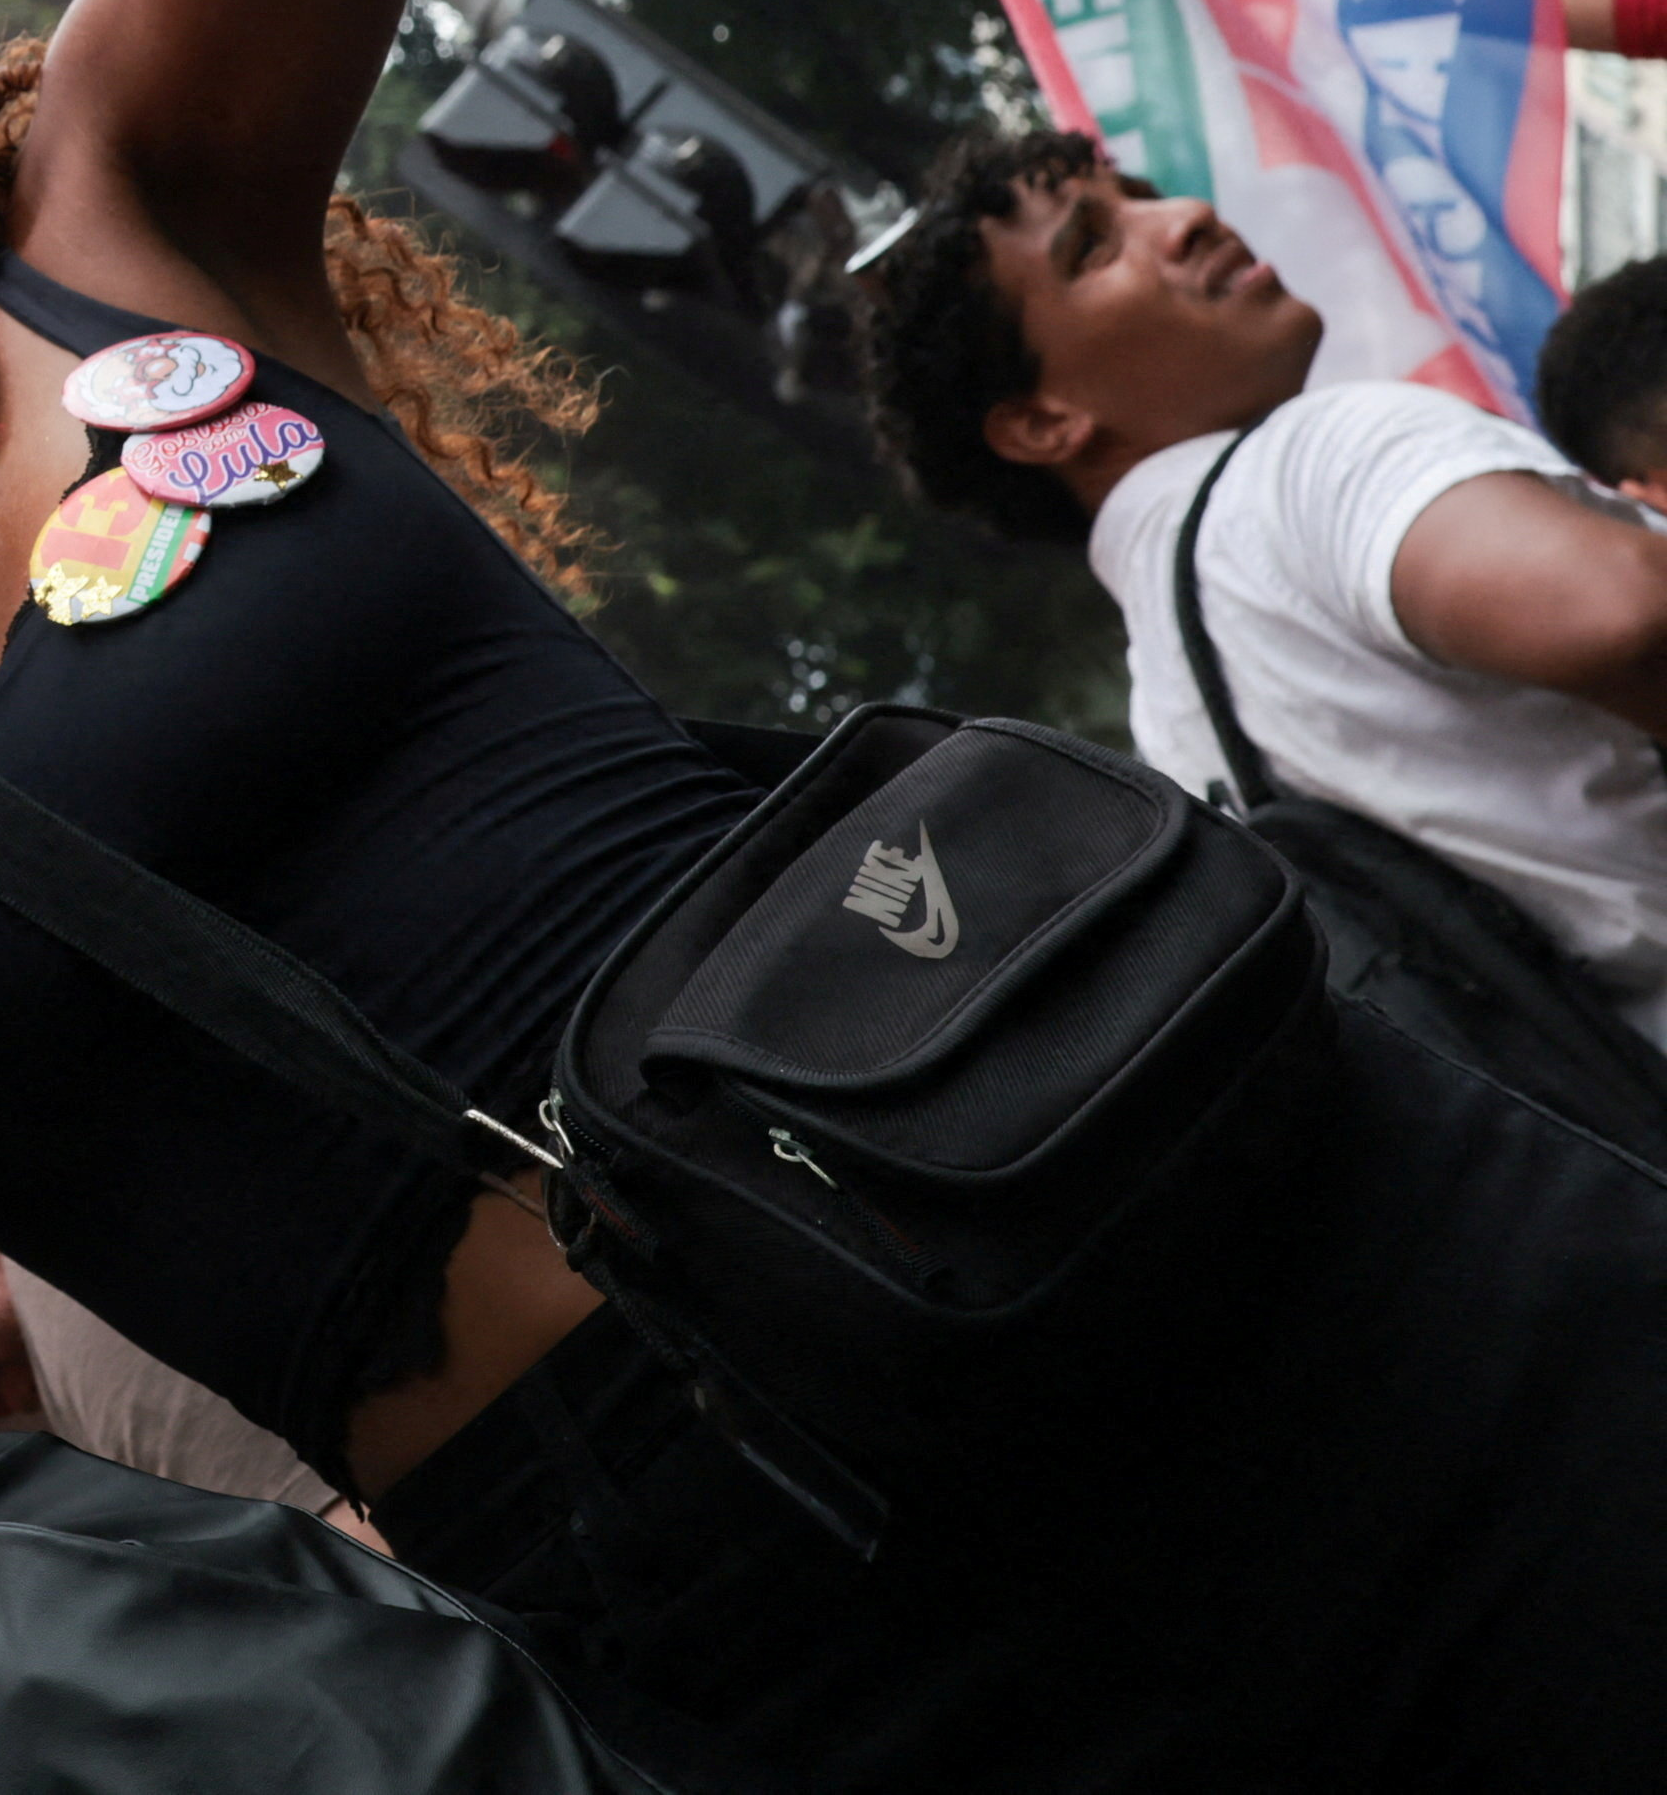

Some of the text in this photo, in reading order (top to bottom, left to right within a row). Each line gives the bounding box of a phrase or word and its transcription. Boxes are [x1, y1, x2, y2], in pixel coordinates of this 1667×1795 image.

[169, 422, 323, 505] Lula
[201, 428, 247, 453] com
[40, 469, 150, 571] 13
[842, 839, 923, 929] NIKE
